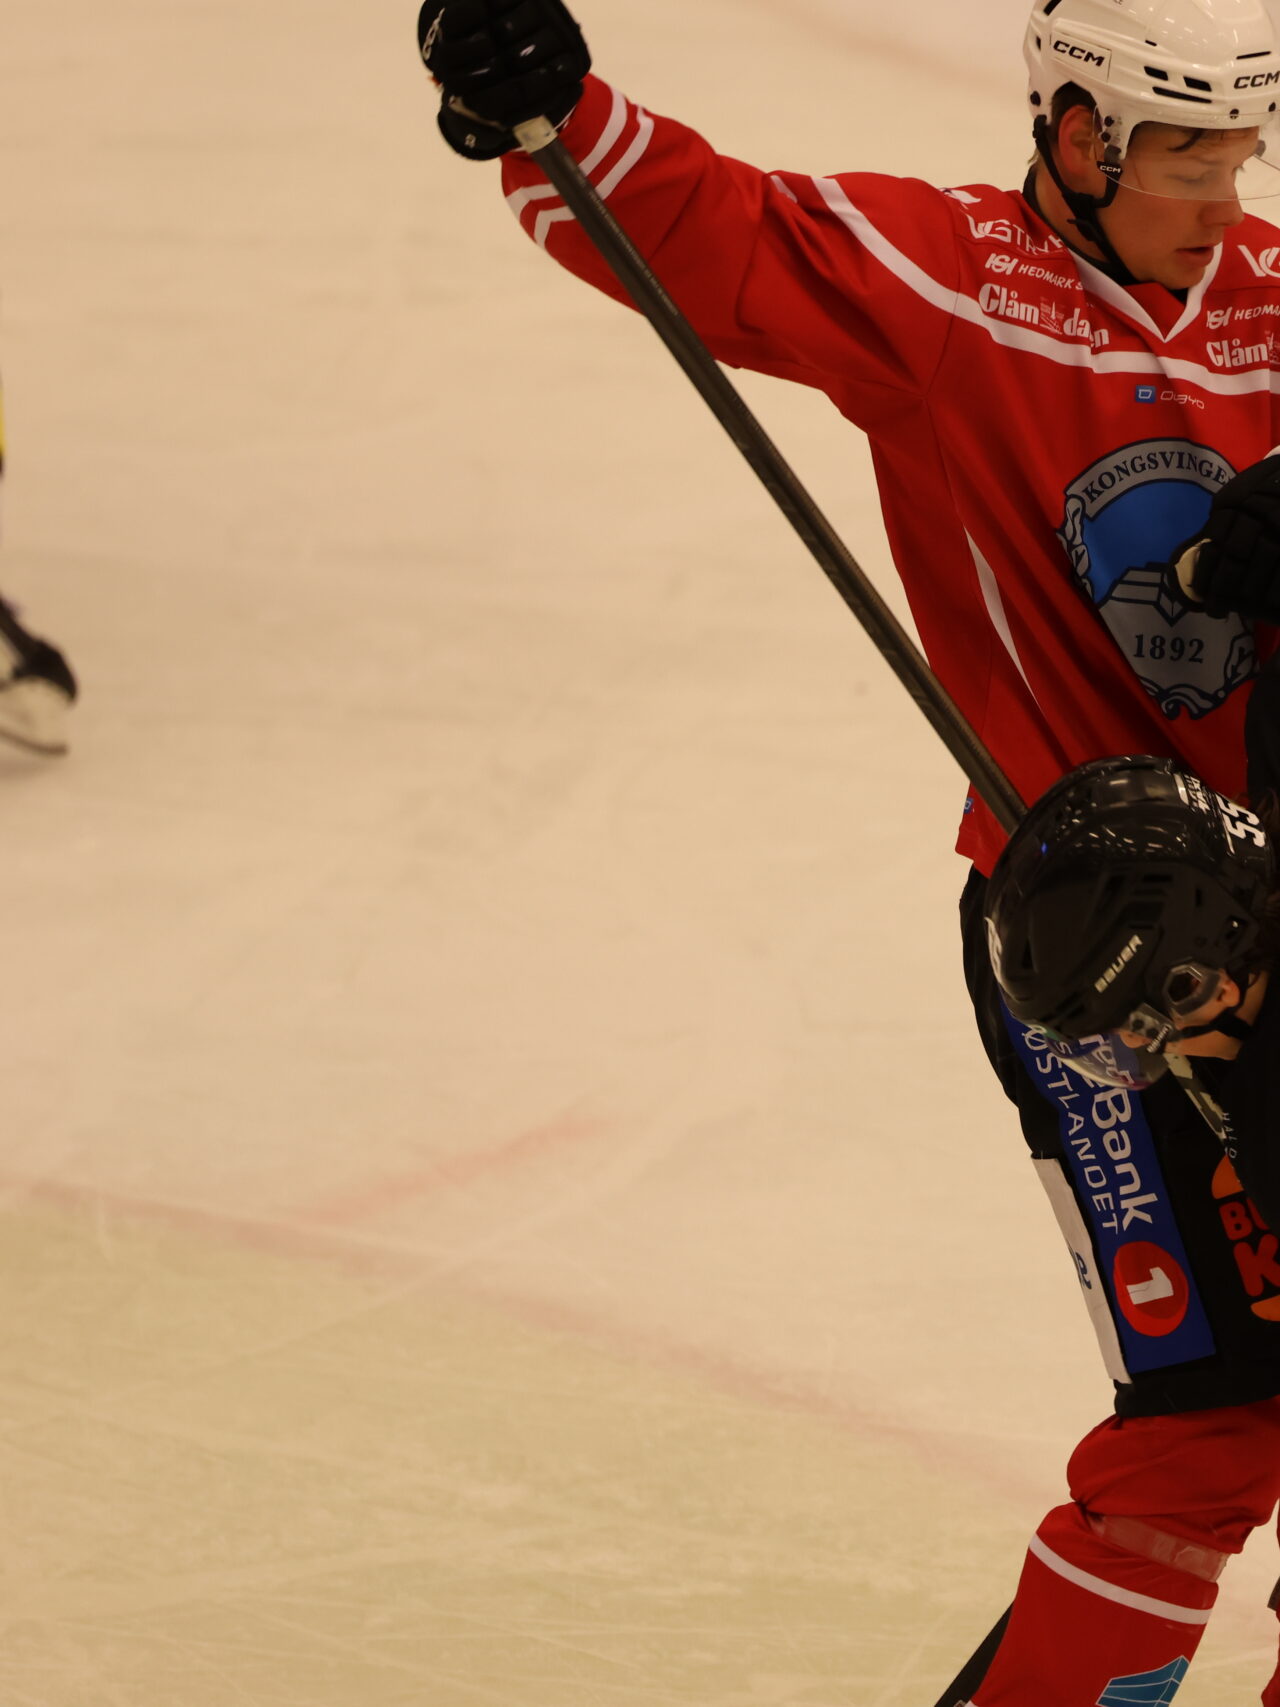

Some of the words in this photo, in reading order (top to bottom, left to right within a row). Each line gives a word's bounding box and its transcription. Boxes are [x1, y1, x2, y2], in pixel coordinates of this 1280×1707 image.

[1053, 39, 1105, 67] CCM
[1233, 70, 1280, 90] CCM
[1099, 164, 1122, 174] CCM
[1018, 263, 1074, 290] HEDMARK
[1083, 450, 1229, 503] KONGSVINGE
[1133, 633, 1205, 664] 1892
[1215, 792, 1266, 848] 55
[1021, 1024, 1121, 1235] ØSTLANDET
[1126, 1266, 1175, 1306] 1
